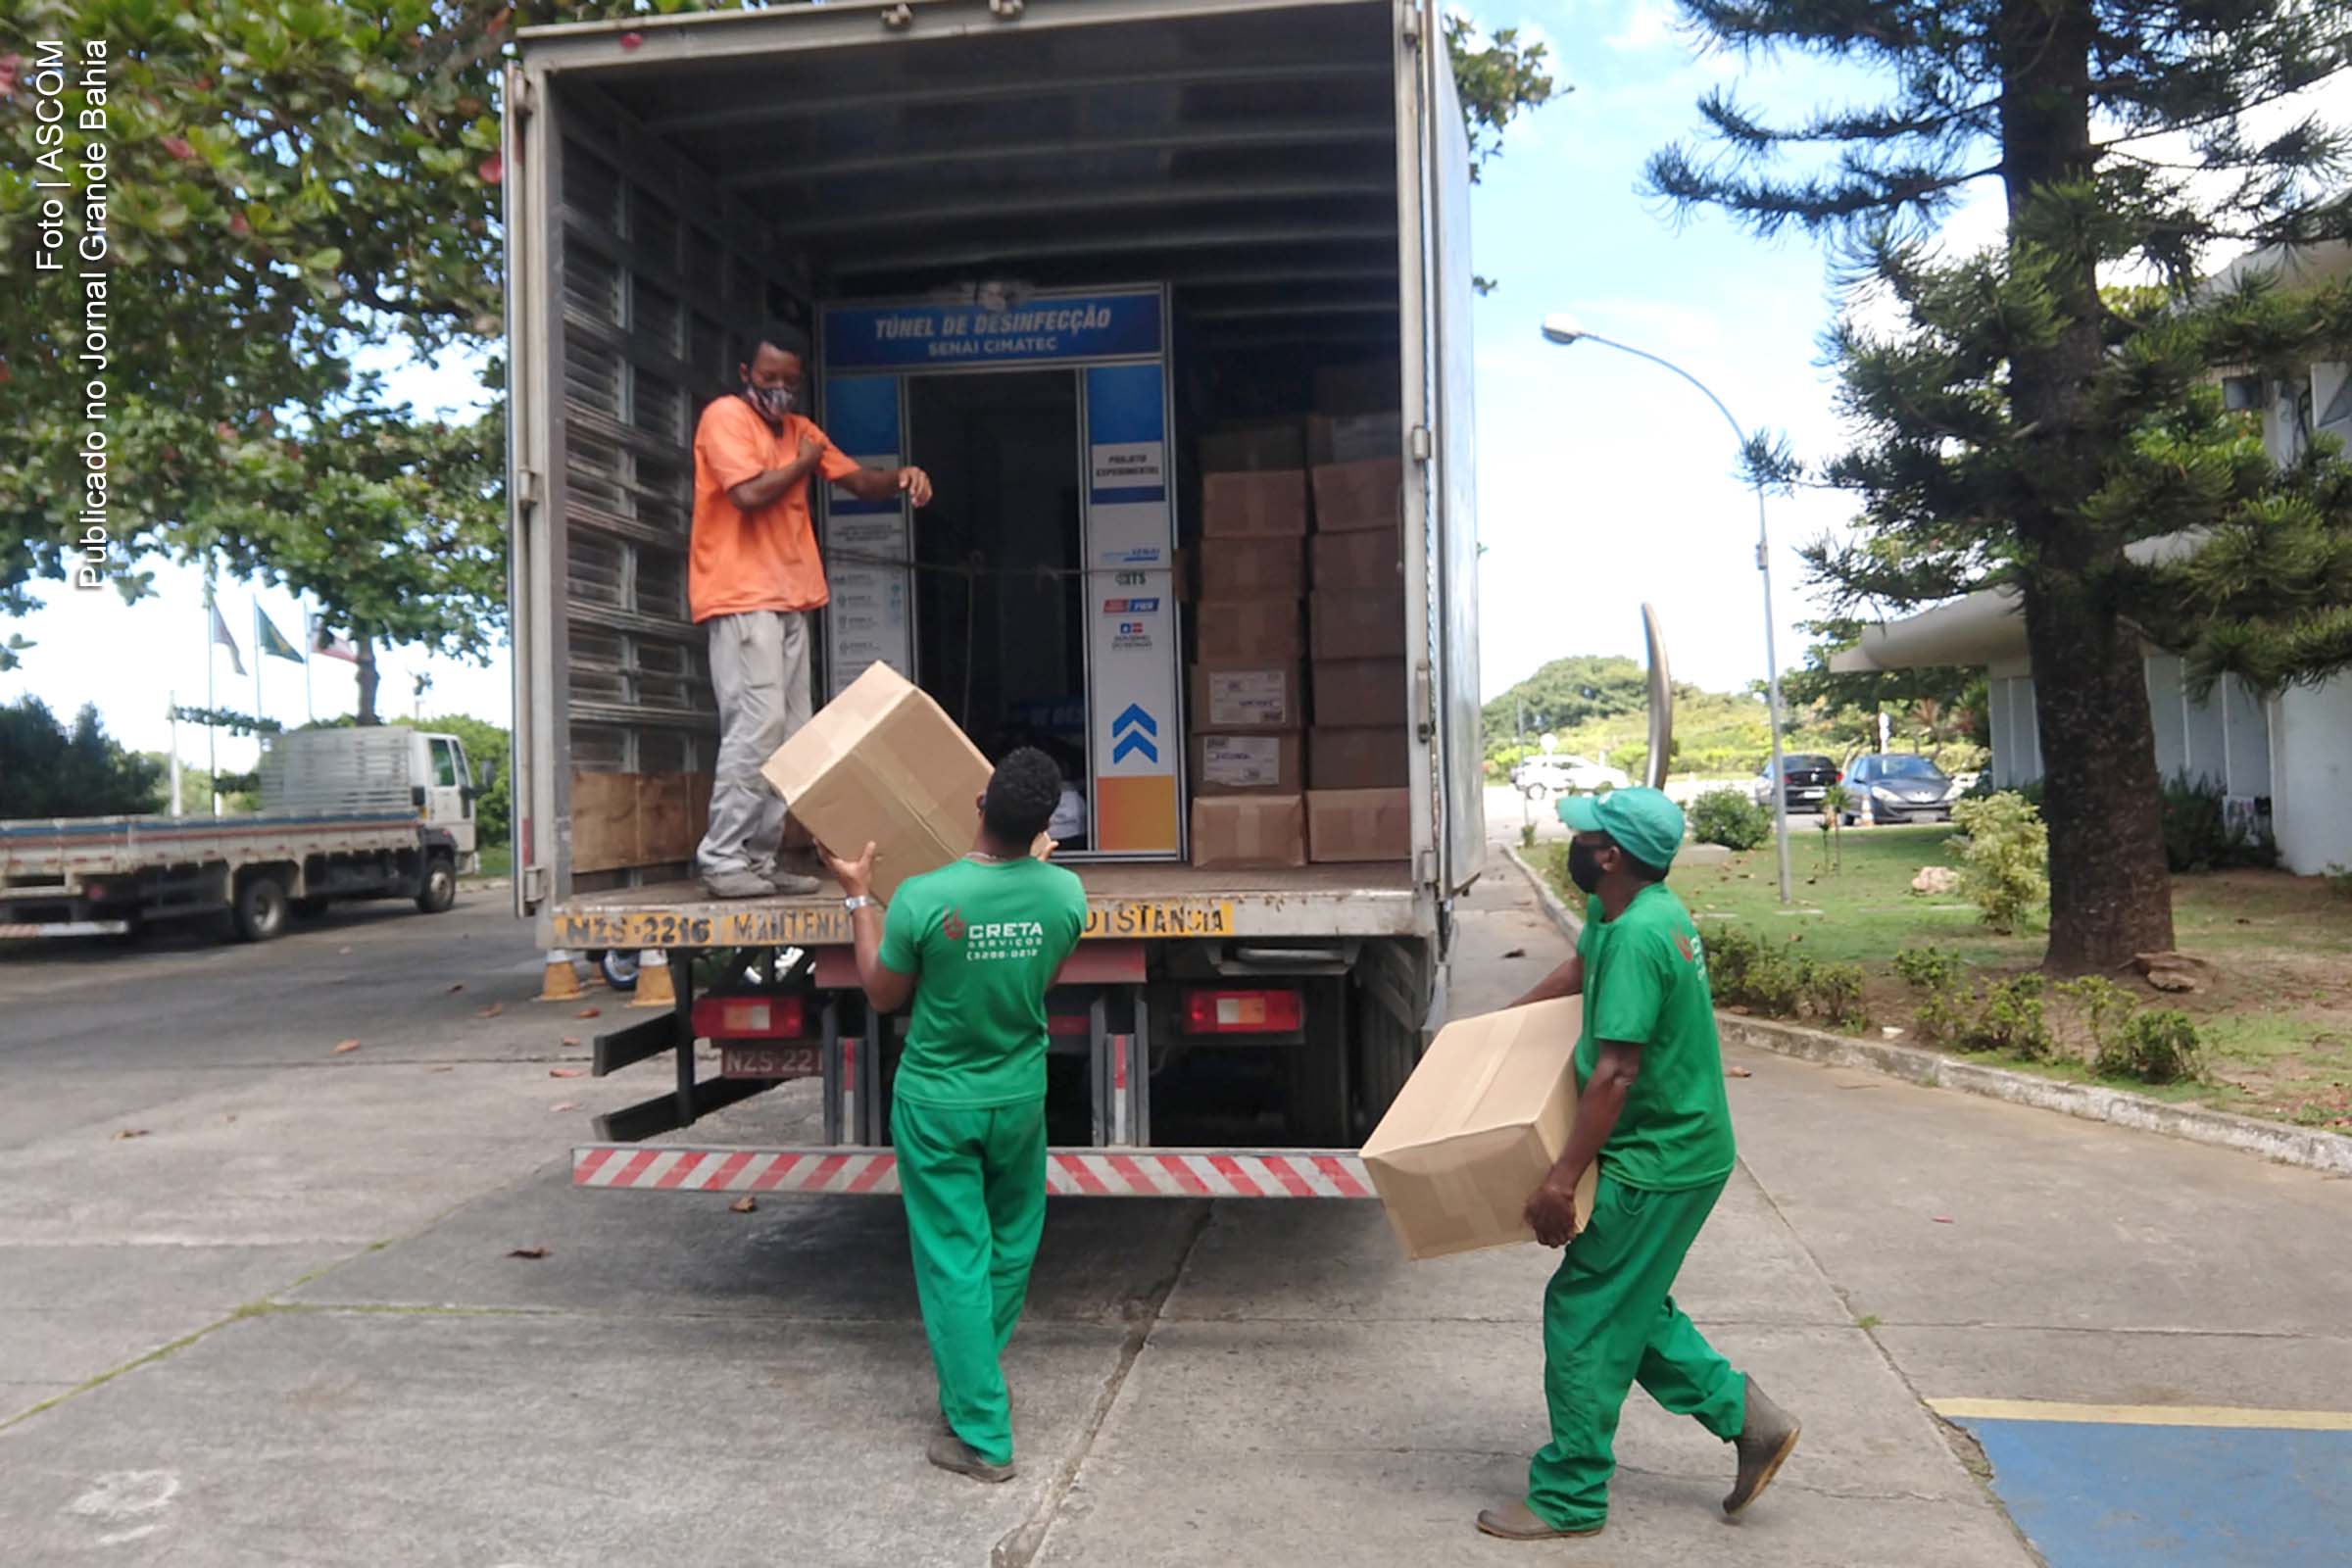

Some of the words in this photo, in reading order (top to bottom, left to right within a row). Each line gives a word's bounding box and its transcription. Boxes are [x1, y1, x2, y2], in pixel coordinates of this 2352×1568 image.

[941, 316, 967, 334] DE
[974, 305, 1111, 334] DESINFECÇÃO
[968, 922, 1044, 940] CRETA
